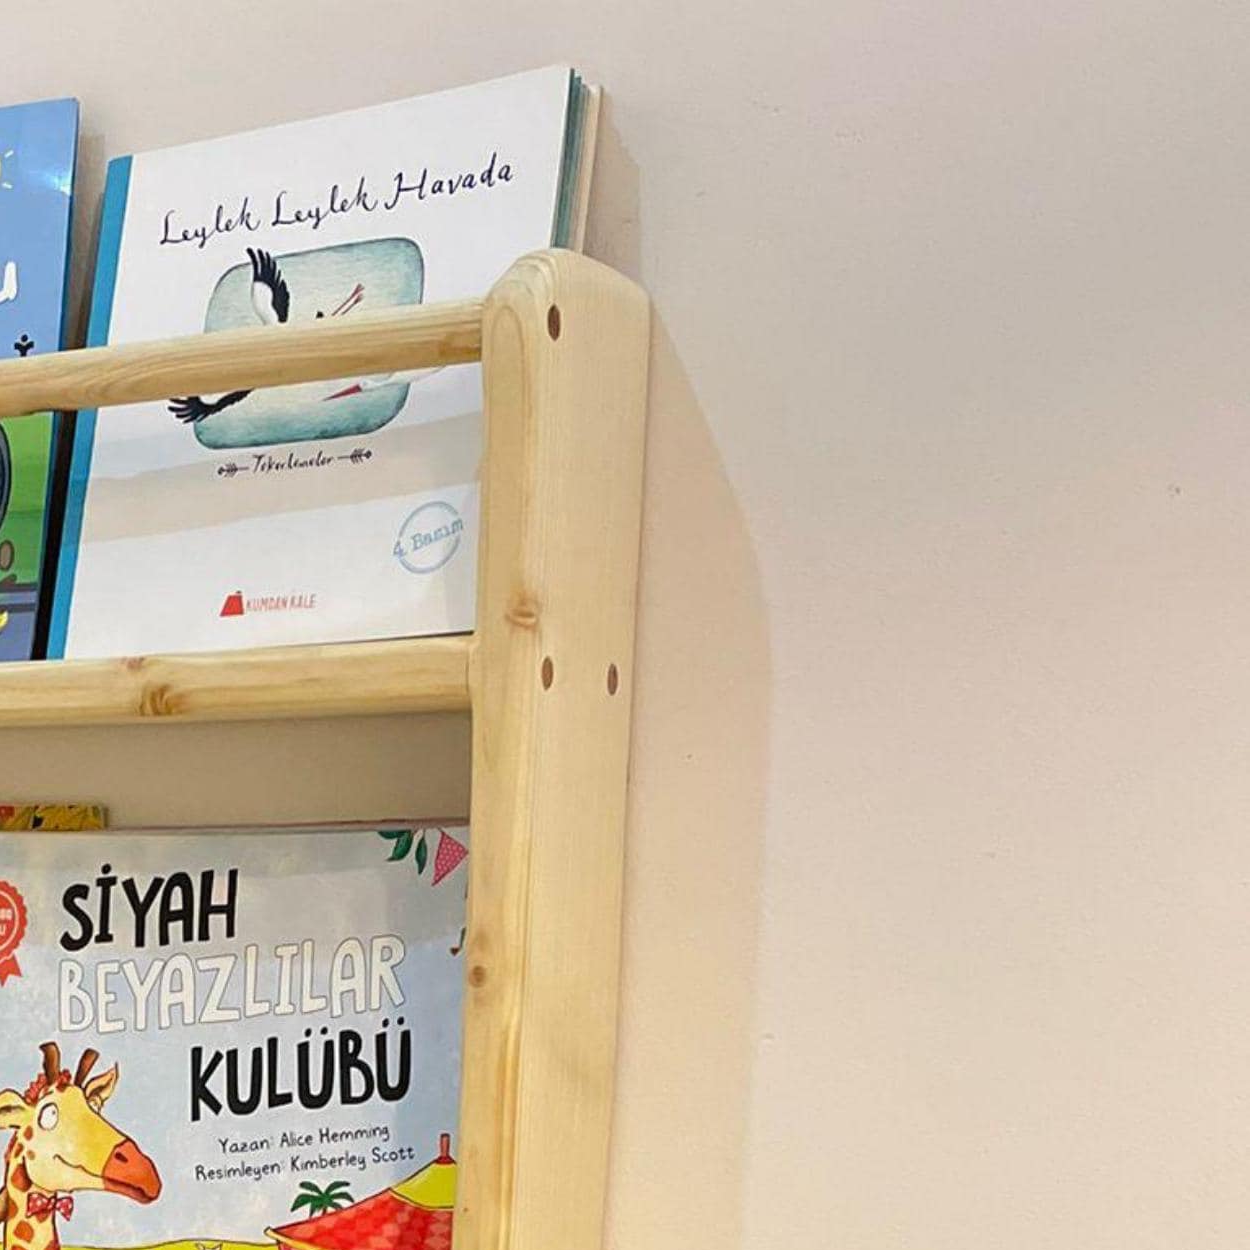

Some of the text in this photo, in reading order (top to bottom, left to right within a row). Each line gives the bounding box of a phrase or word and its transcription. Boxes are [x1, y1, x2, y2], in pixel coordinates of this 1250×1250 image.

[160, 152, 513, 248] Leylek Leylek Havada
[59, 863, 239, 952] SİYAH
[58, 934, 407, 1036] BEYAZLILAR
[189, 1017, 412, 1121] KULÜBÜ
[280, 1132, 314, 1148] Alice
[319, 1125, 391, 1142] Hemming
[290, 1150, 366, 1171] Kimberley
[372, 1146, 415, 1163] Scott
